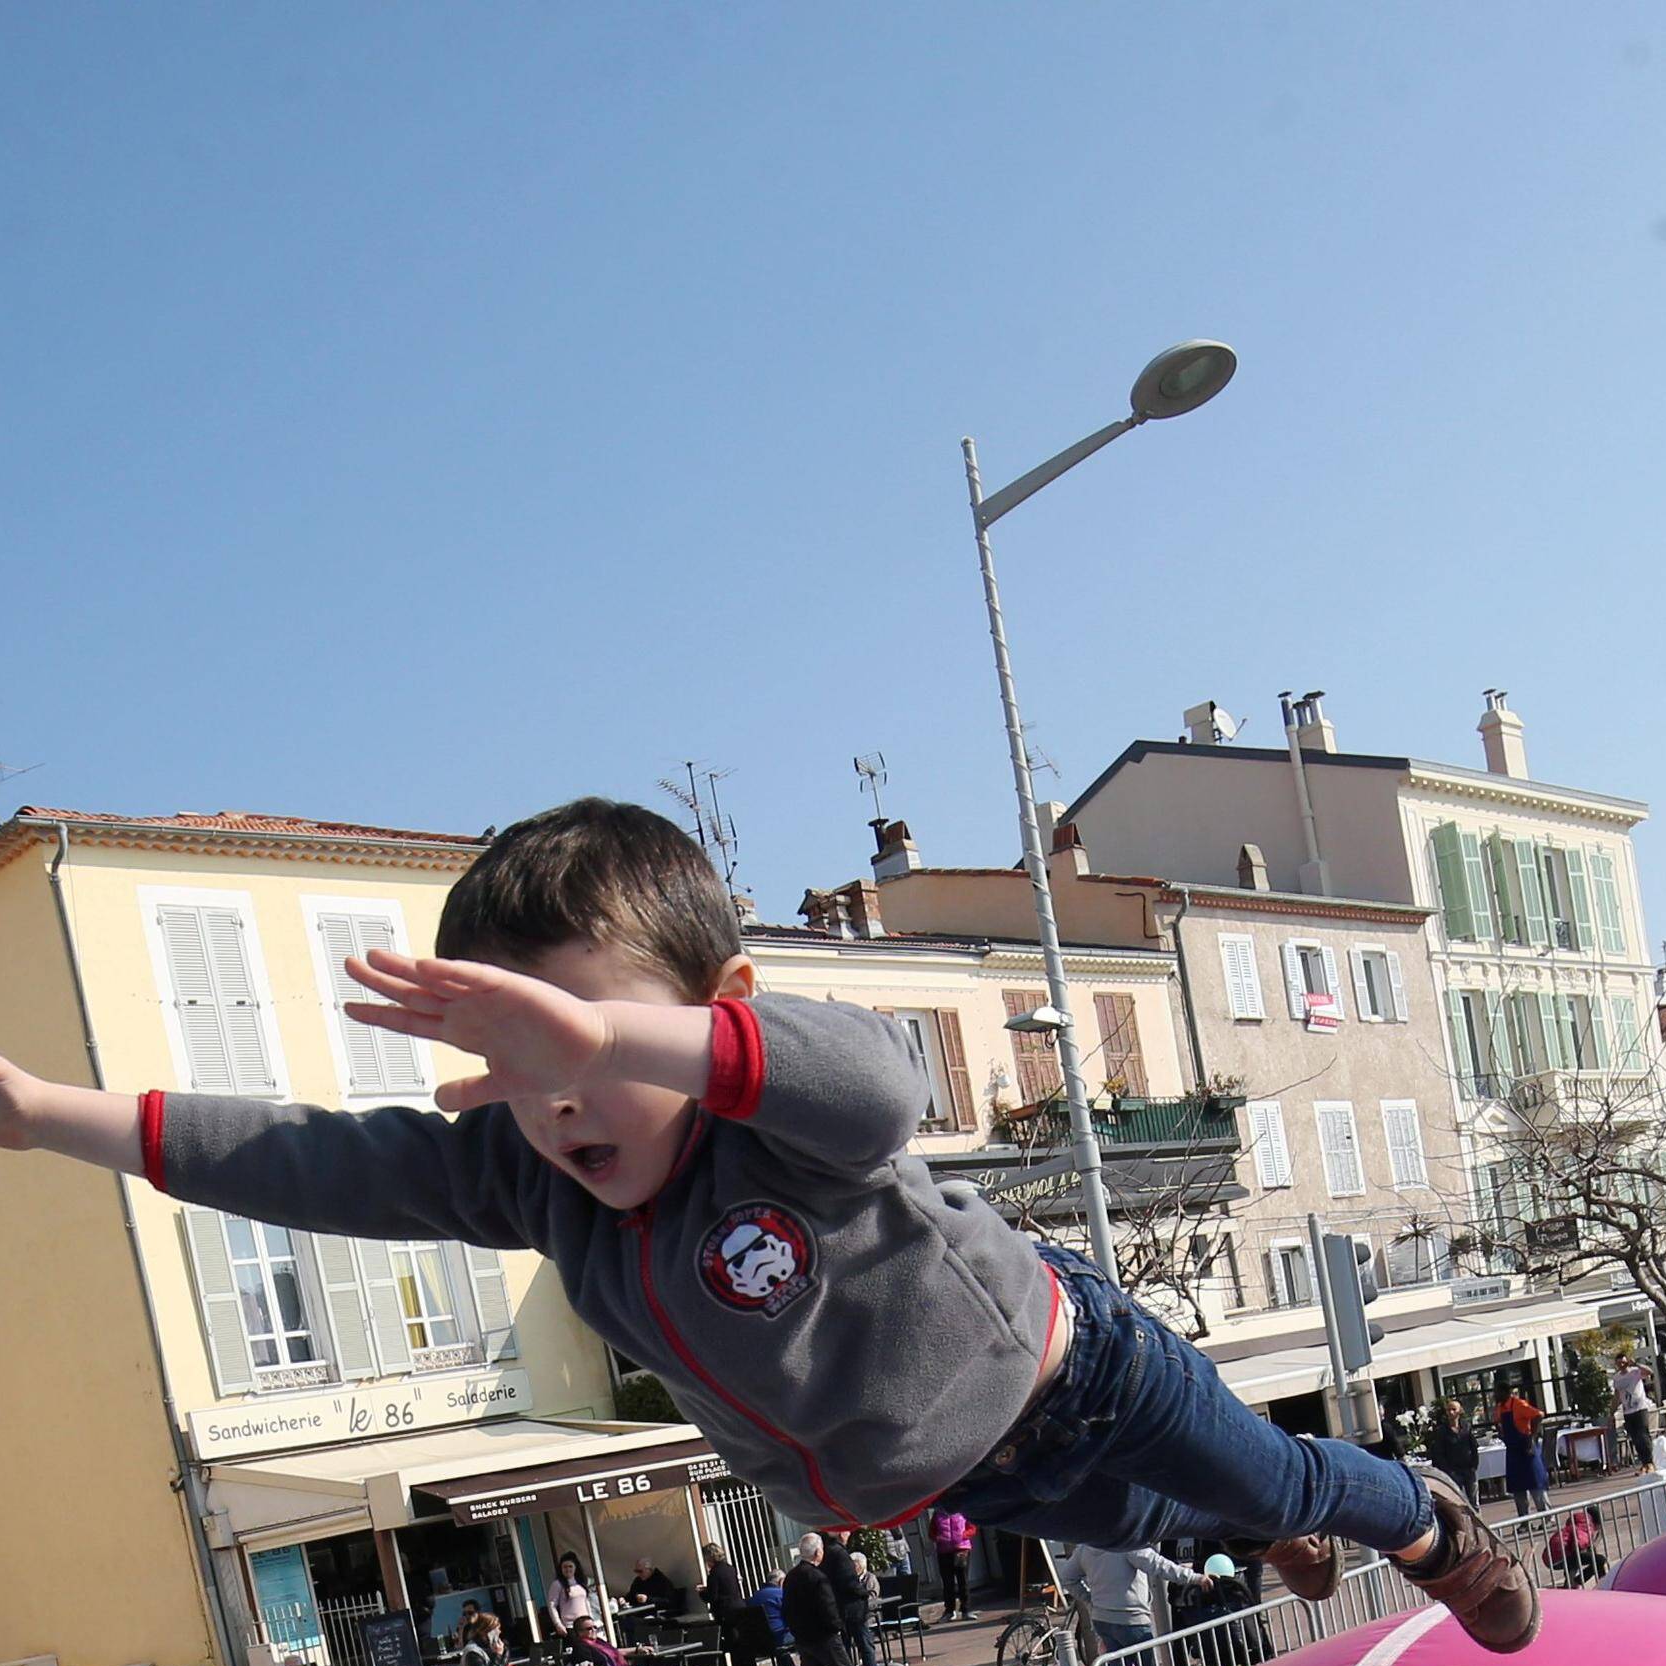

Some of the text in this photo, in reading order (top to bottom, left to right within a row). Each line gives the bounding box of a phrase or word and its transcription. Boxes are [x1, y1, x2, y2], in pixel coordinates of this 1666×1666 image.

[208, 1411, 323, 1443] Sandwicherie
[446, 1385, 517, 1409] Saladerie
[704, 1464, 727, 1474] PLACE
[576, 1474, 652, 1503] LE 86
[469, 1494, 537, 1512] SNACK BURGERS
[471, 1507, 508, 1520] SALADES
